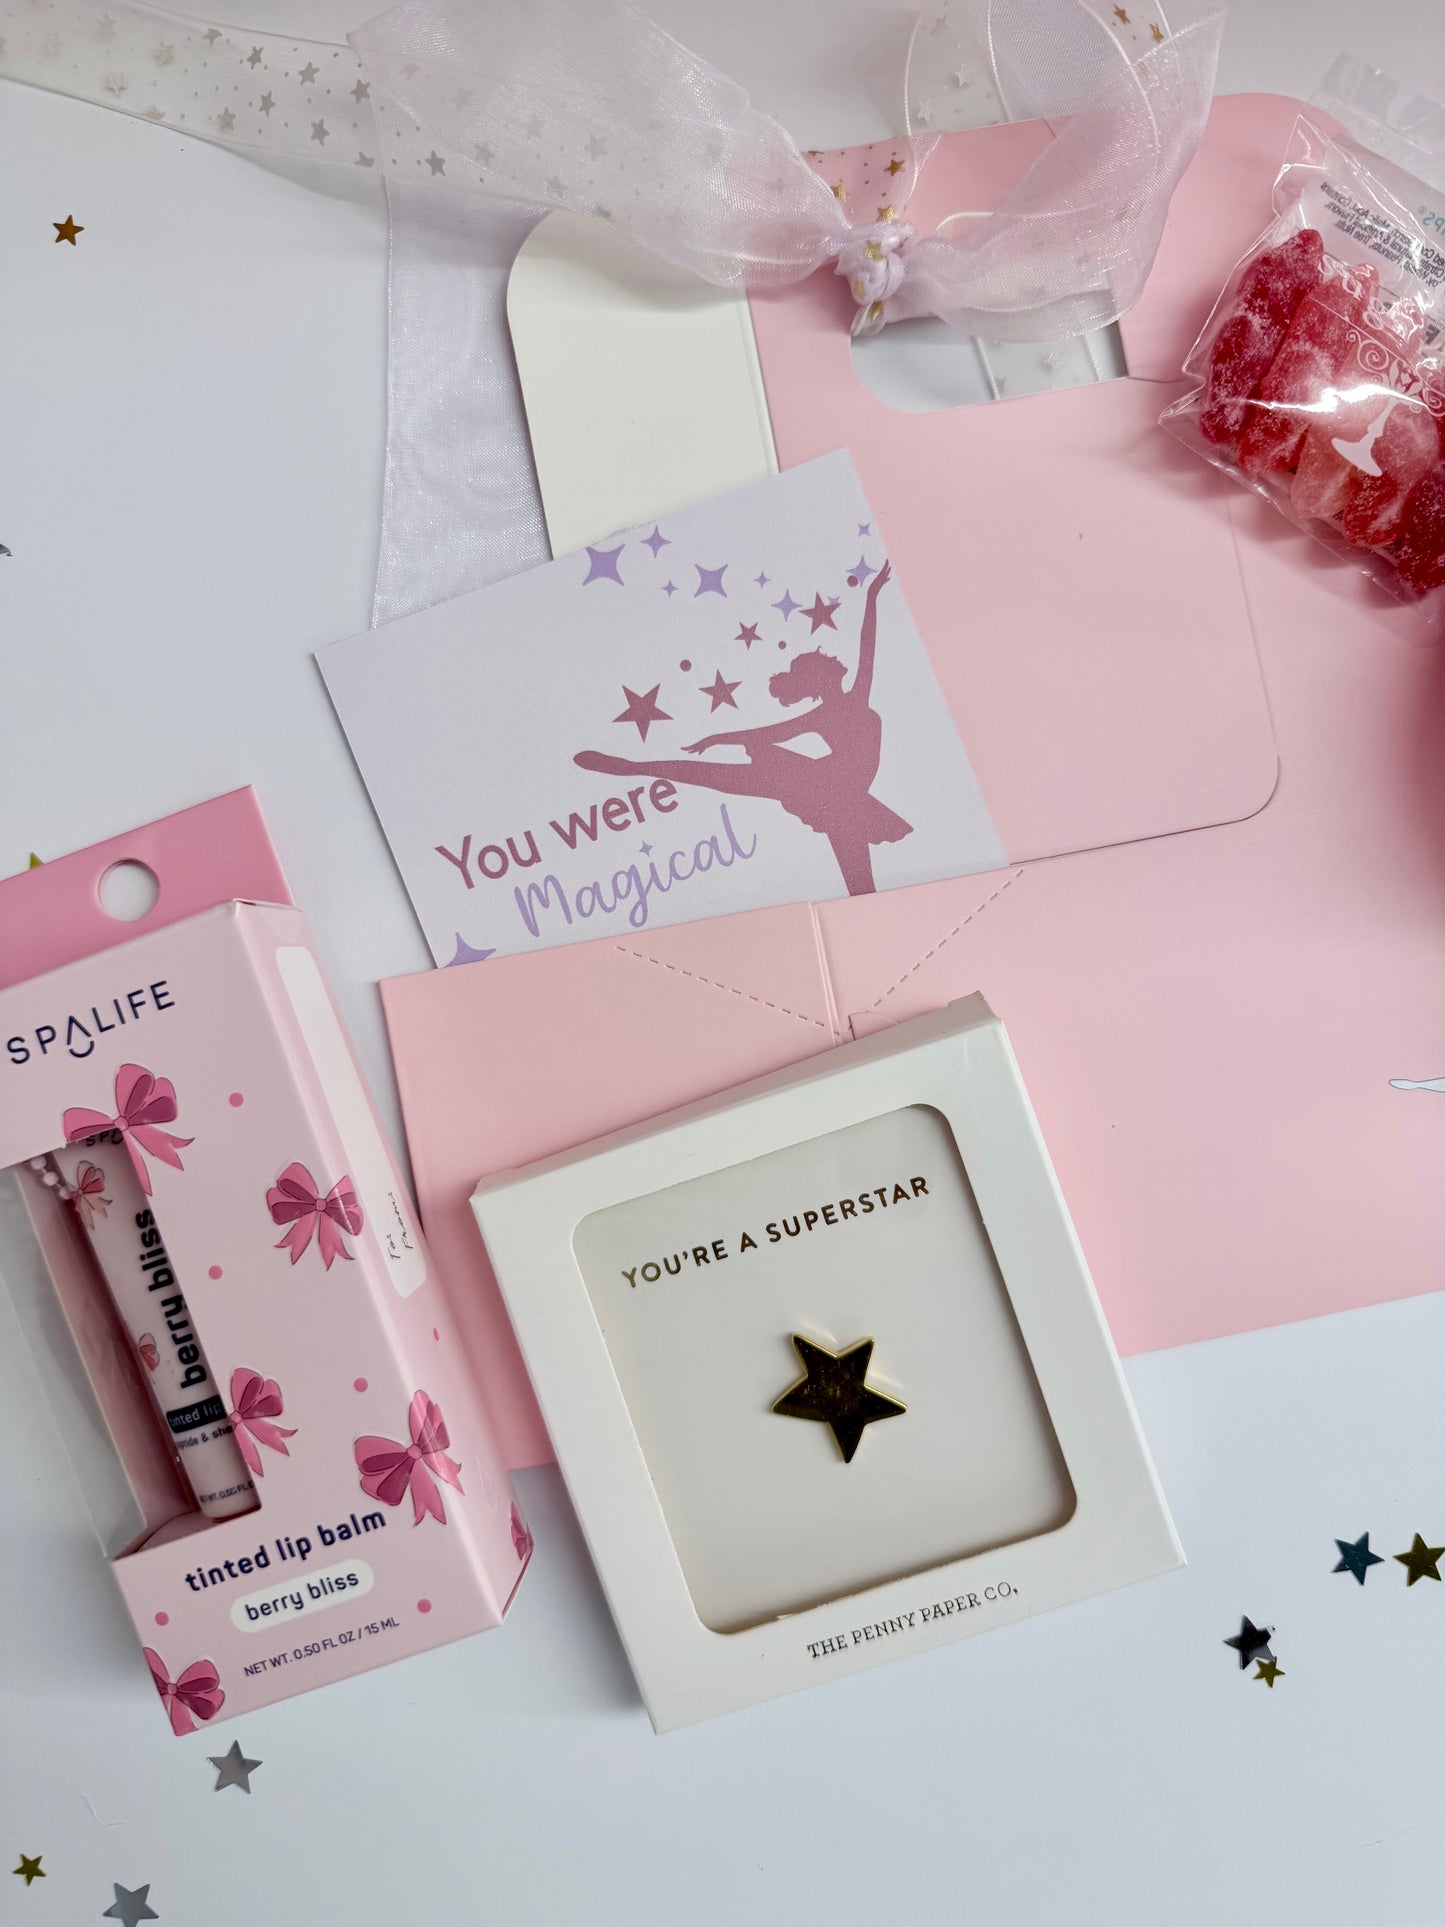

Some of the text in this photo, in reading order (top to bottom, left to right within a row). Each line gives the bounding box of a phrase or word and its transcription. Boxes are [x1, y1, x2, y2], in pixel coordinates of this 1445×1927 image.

[434, 777, 679, 889] You were
[513, 803, 757, 938] Magical
[6, 980, 176, 1064] SPALIFE
[739, 1231, 758, 1253] A
[764, 1176, 930, 1243] SUPERSTAR
[135, 1208, 208, 1389] berry bliss
[201, 1432, 210, 1442] &
[185, 1511, 388, 1592] tinted lip balm
[245, 1571, 360, 1622] berry bliss
[807, 1634, 848, 1659] THE
[851, 1612, 916, 1645] PENNY
[920, 1592, 982, 1623] PAPER
[243, 1616, 401, 1678] NET WT. 0.50 FL OZ / 15 ML
